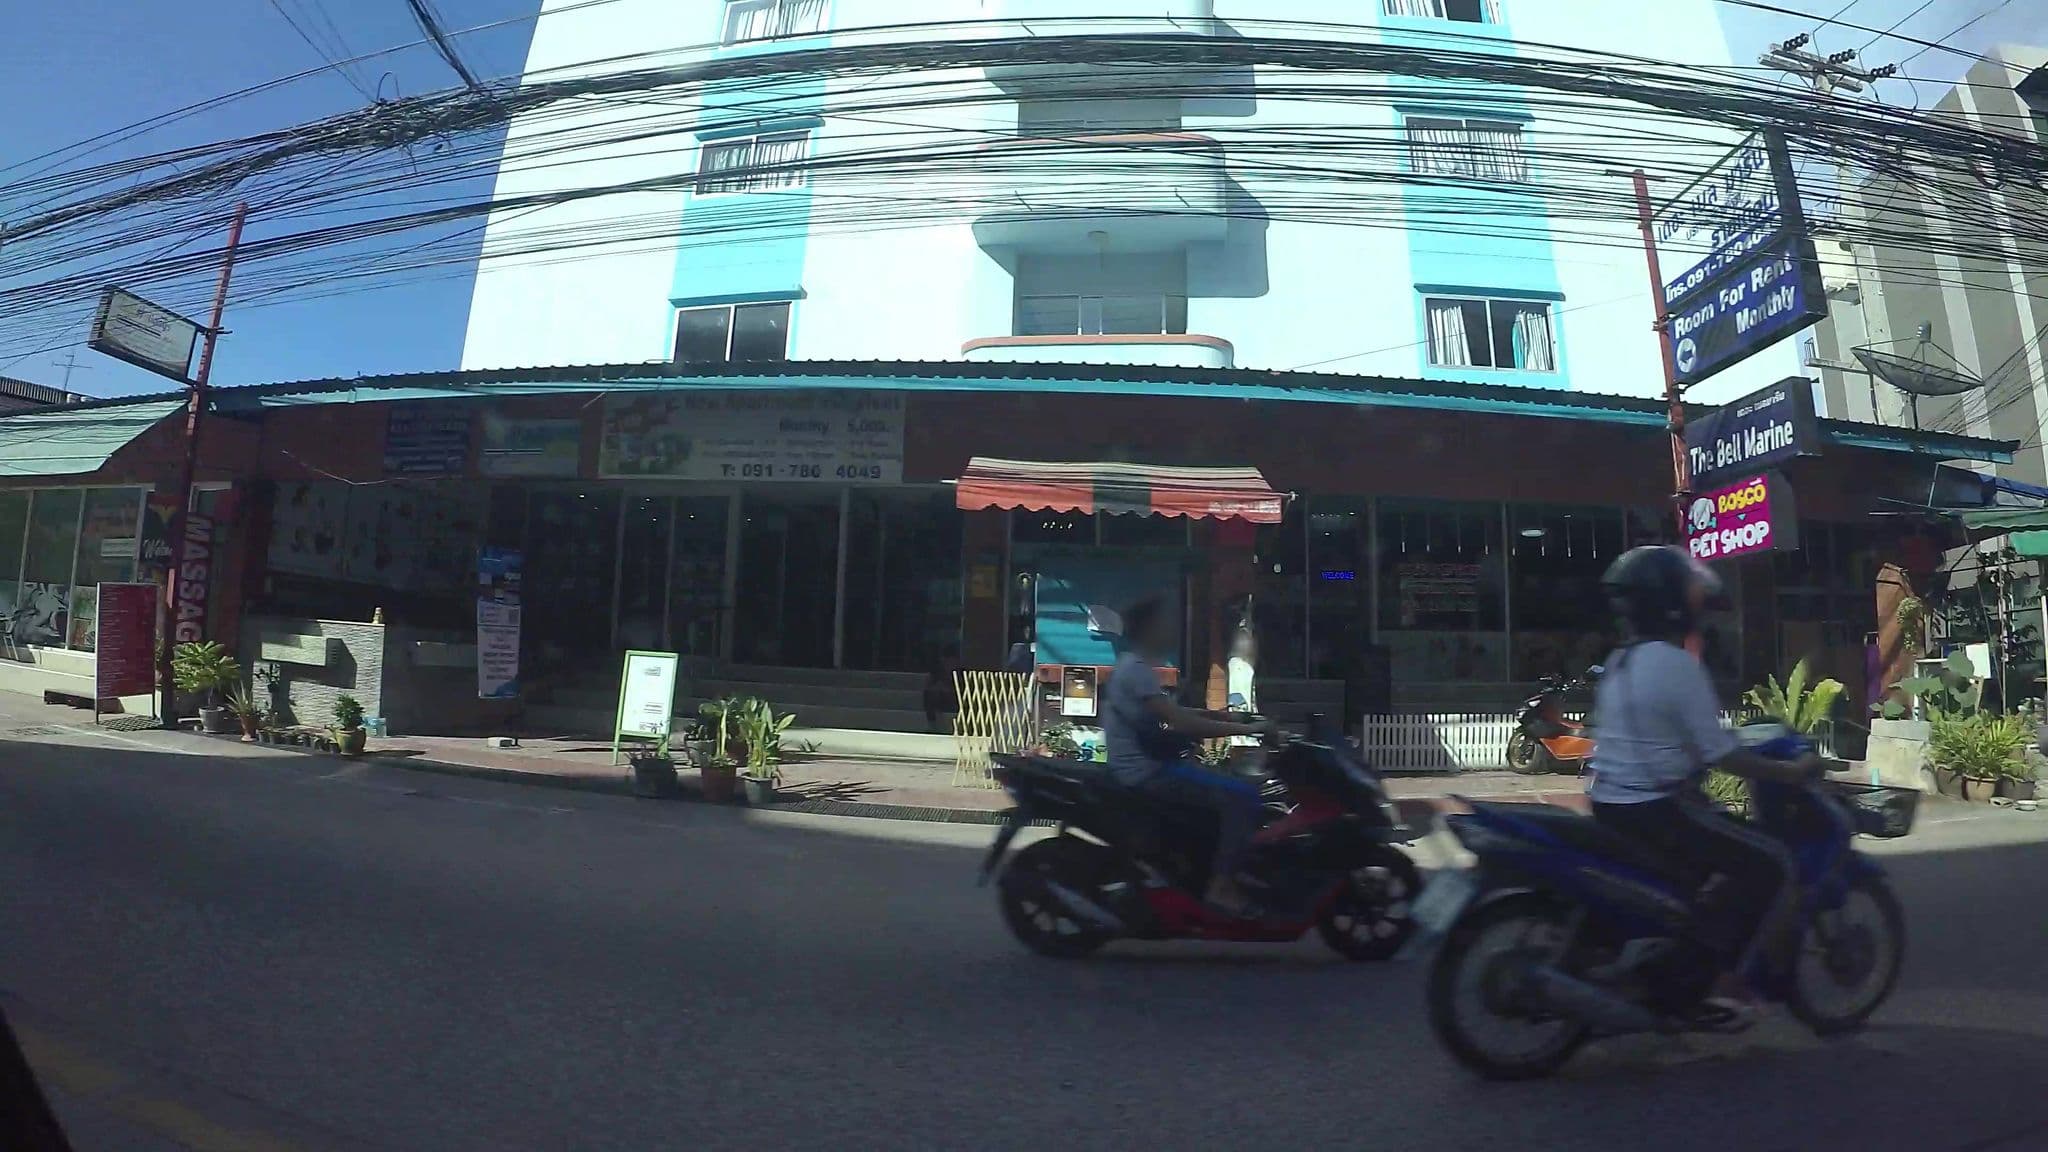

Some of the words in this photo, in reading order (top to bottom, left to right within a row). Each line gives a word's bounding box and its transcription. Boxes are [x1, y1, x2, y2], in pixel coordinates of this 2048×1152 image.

[1674, 302, 1714, 340] Room
[1719, 282, 1746, 313] For
[1750, 252, 1793, 292] Rent
[1735, 285, 1796, 334] Monthly
[1689, 446, 1714, 476] The
[1716, 432, 1742, 468] Bell
[1744, 419, 1794, 460] Marine
[1689, 531, 1720, 559] PET
[1720, 520, 1770, 554] SHOP
